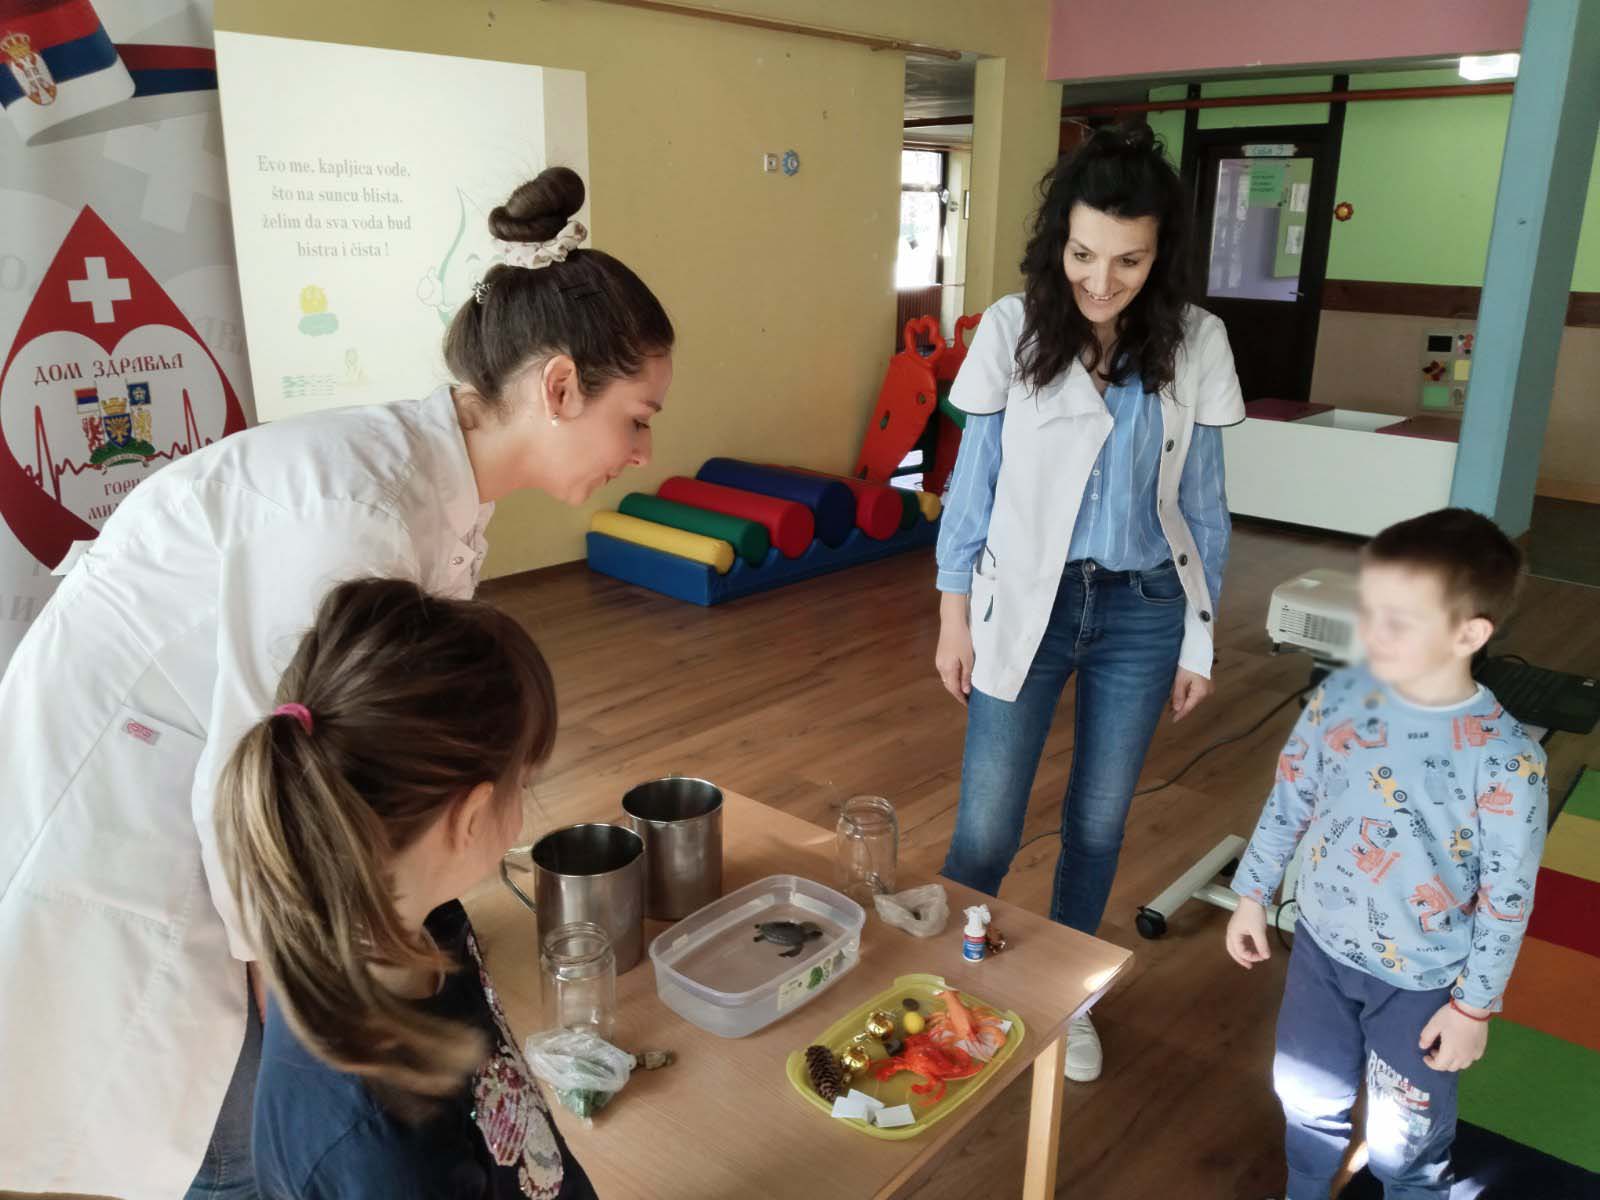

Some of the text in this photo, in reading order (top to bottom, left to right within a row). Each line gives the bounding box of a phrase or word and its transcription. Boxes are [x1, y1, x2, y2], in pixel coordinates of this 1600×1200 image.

[256, 154, 286, 172] Evo
[318, 158, 373, 178] kapljica
[271, 185, 294, 201] što
[296, 189, 314, 201] na
[318, 190, 359, 202] suncu
[304, 213, 322, 229] da
[326, 217, 348, 229] sva
[351, 214, 384, 230] voda
[296, 241, 338, 257] bistra
[34, 353, 184, 386] ДОМ ЗДРАВЉА
[104, 478, 141, 496] ГОР
